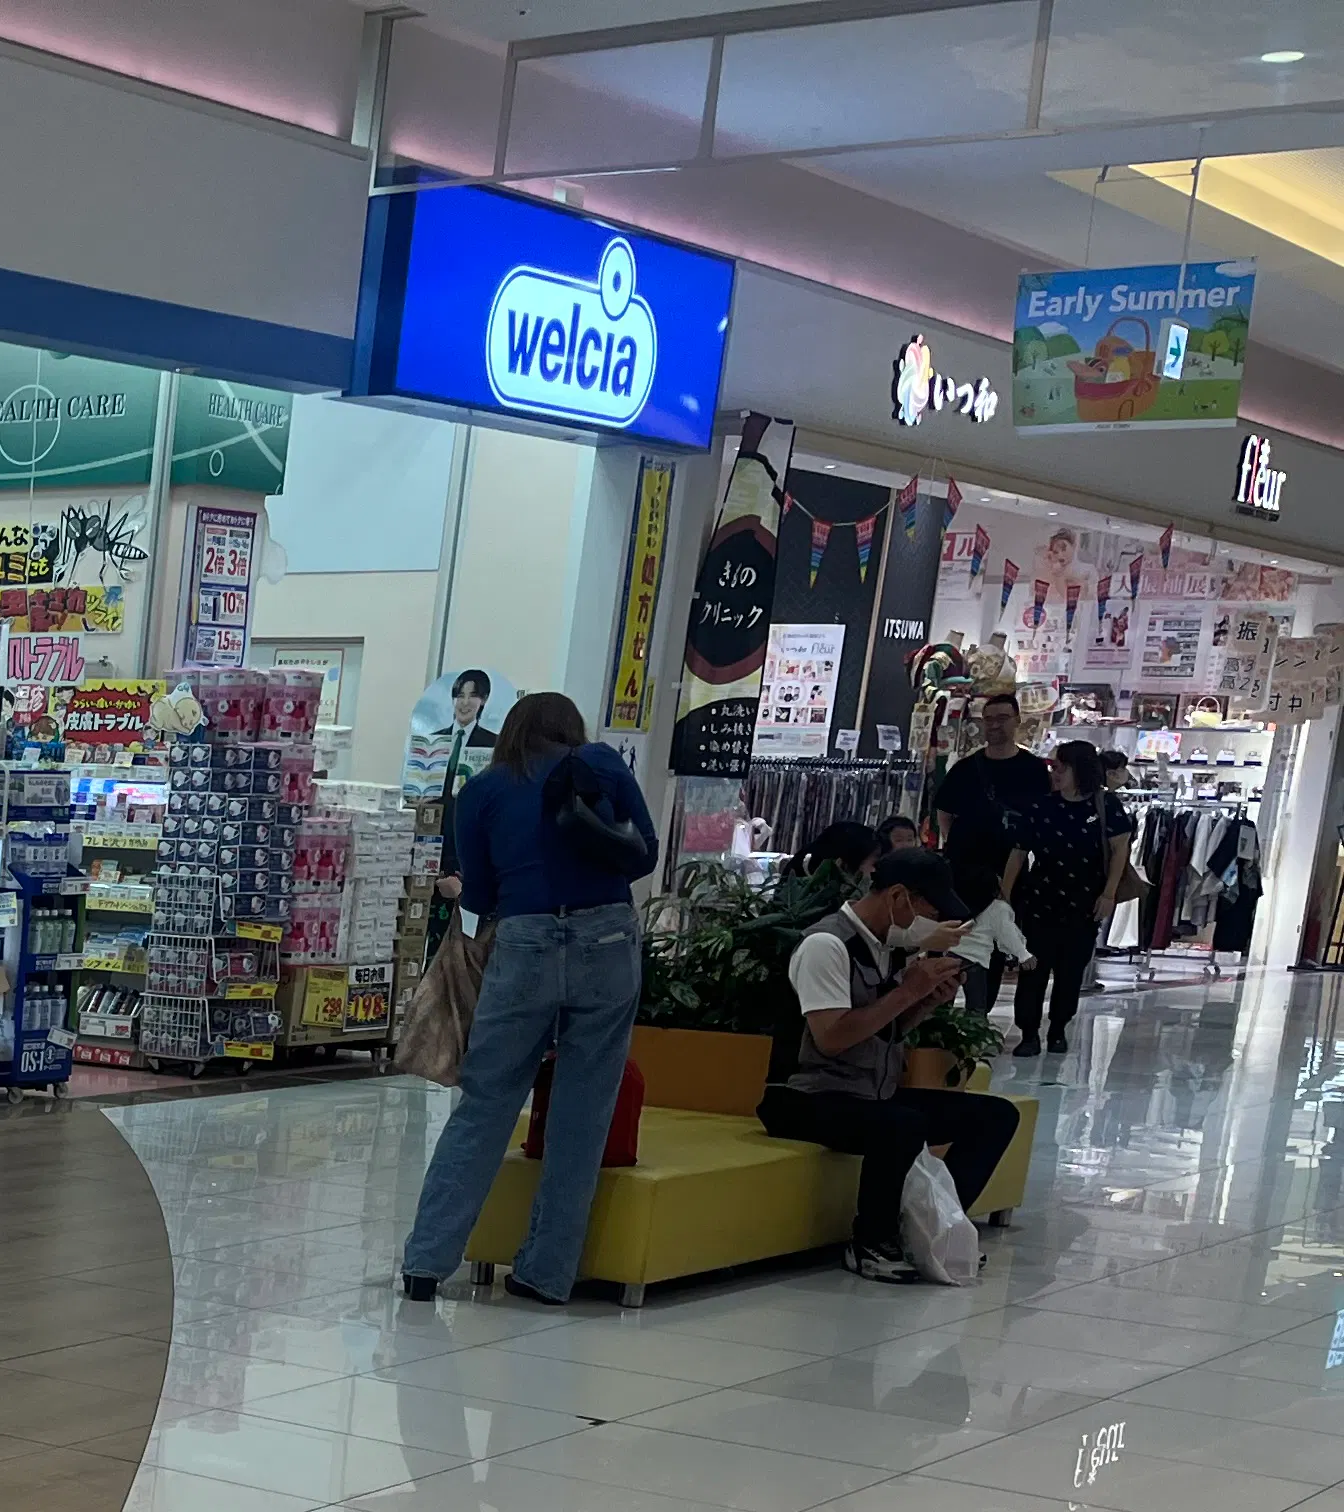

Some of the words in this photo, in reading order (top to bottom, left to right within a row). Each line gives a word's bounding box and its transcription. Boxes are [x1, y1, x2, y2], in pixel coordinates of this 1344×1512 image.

[1027, 287, 1103, 323] Early
[1110, 283, 1242, 314] Summer
[507, 302, 638, 398] welcia
[65, 393, 126, 418] CARE
[208, 393, 252, 420] HEALTH
[253, 402, 286, 430] CARE
[204, 546, 215, 574] 2
[227, 549, 238, 576] 3
[623, 553, 657, 699] 処方せん
[698, 601, 763, 630] クリニック
[883, 617, 925, 640] ITSUWA
[63, 713, 145, 733] 皮膚トラブル
